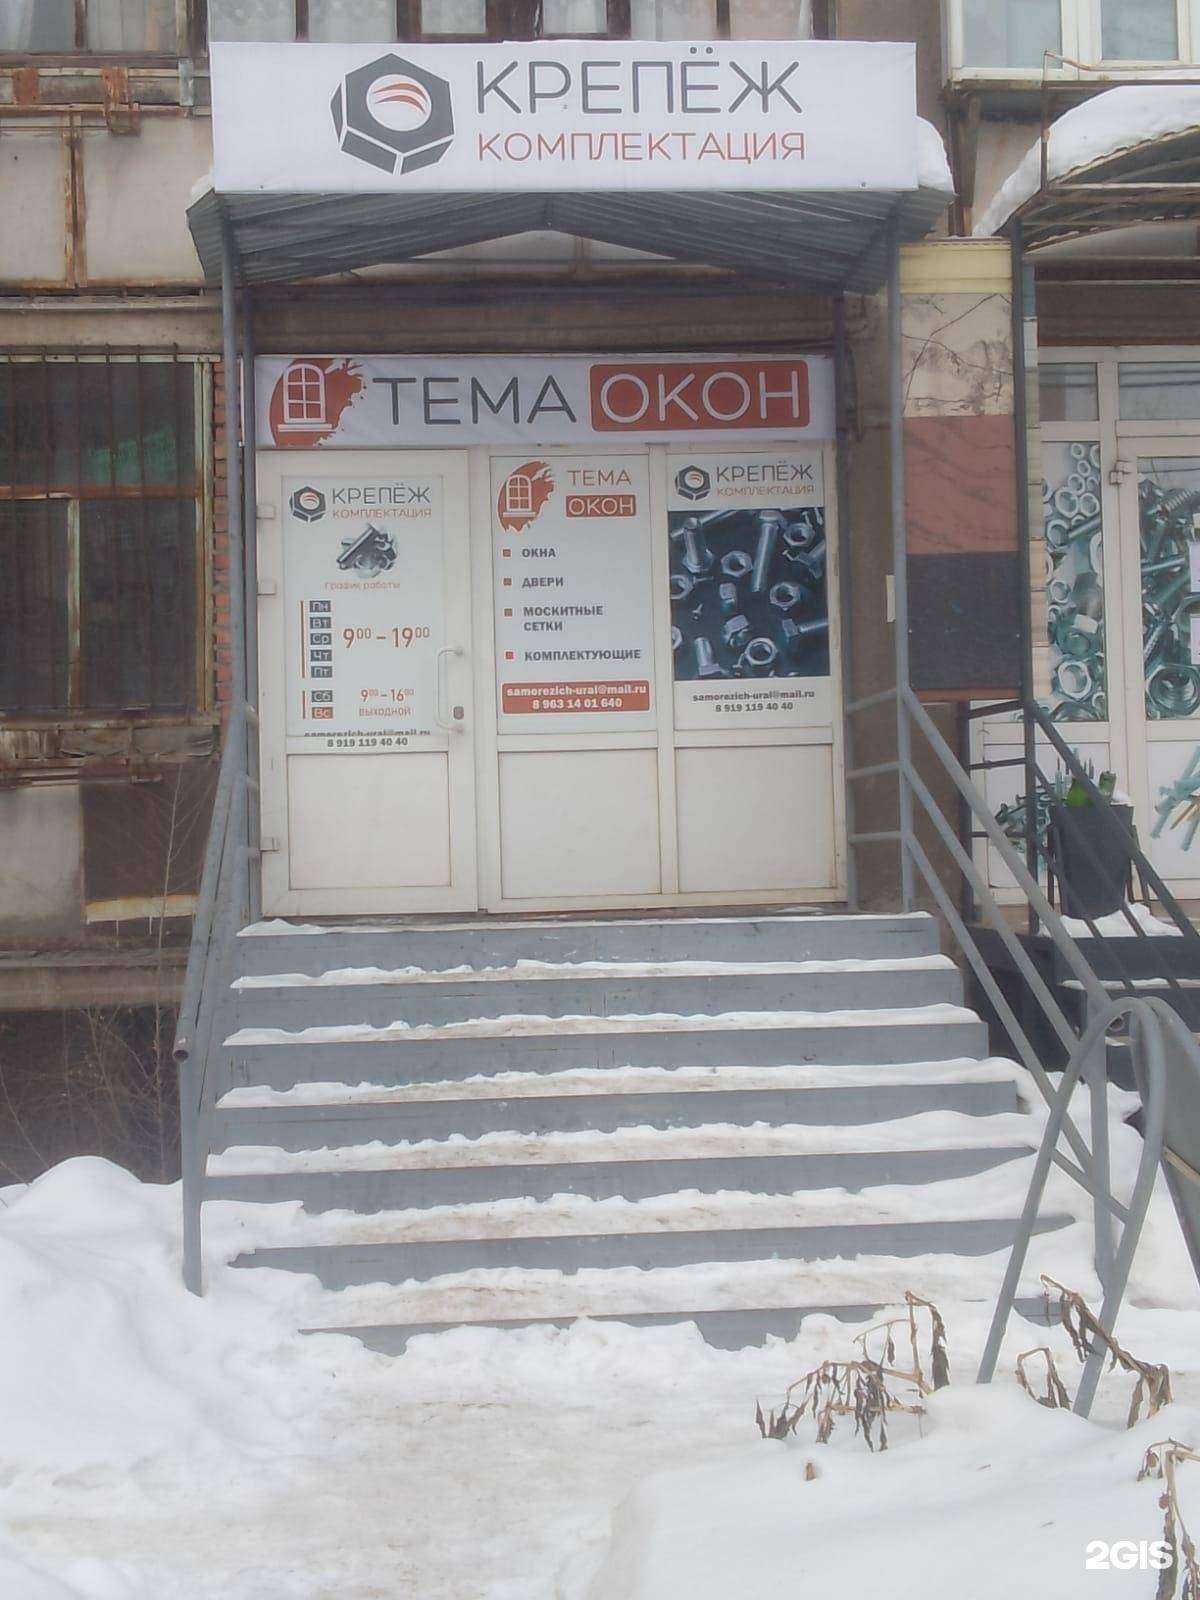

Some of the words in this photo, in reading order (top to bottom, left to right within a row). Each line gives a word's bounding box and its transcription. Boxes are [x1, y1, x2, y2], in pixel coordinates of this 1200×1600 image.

[475, 45, 803, 114] КРЕПЁЖ
[477, 131, 805, 163] КОМПЛЕКТАЦИЯ
[372, 374, 578, 425] ТЕМА
[599, 369, 799, 421] ОКОН
[716, 460, 813, 482] КРЕПЁЖ
[567, 469, 632, 487] ТЕМА
[332, 482, 430, 504] КРЕПЁЖ
[717, 484, 815, 497] КОМПЛЕКТАЦИЯ
[568, 496, 634, 515] ОКОН
[332, 507, 432, 519] КОМПЛЕКТАЦИЯ
[521, 547, 556, 558] ОКНА
[522, 576, 564, 588] ДВЕРИ
[523, 605, 603, 617] МОСКИТНЫЕ
[524, 620, 563, 632] СЕТКИ
[312, 634, 330, 644] Ср
[525, 648, 641, 662] КОМПЛЕКТУЮЩИЕ
[507, 684, 647, 696] samorezich-ural@mail.ru
[692, 690, 815, 702] samorezich-ural@mail.ru
[532, 699, 540, 710] 8
[543, 699, 563, 709] 963
[567, 699, 580, 709] 14
[584, 698, 599, 708] 01
[601, 698, 622, 708] 640
[715, 704, 722, 713] 8
[724, 703, 743, 713] 919
[745, 702, 764, 712] 119
[766, 702, 779, 711] 40
[781, 701, 794, 711] 40
[327, 739, 334, 748] 8
[337, 738, 355, 747] 919
[359, 738, 377, 747] 119
[380, 737, 393, 746] 40
[396, 737, 408, 746] 40
